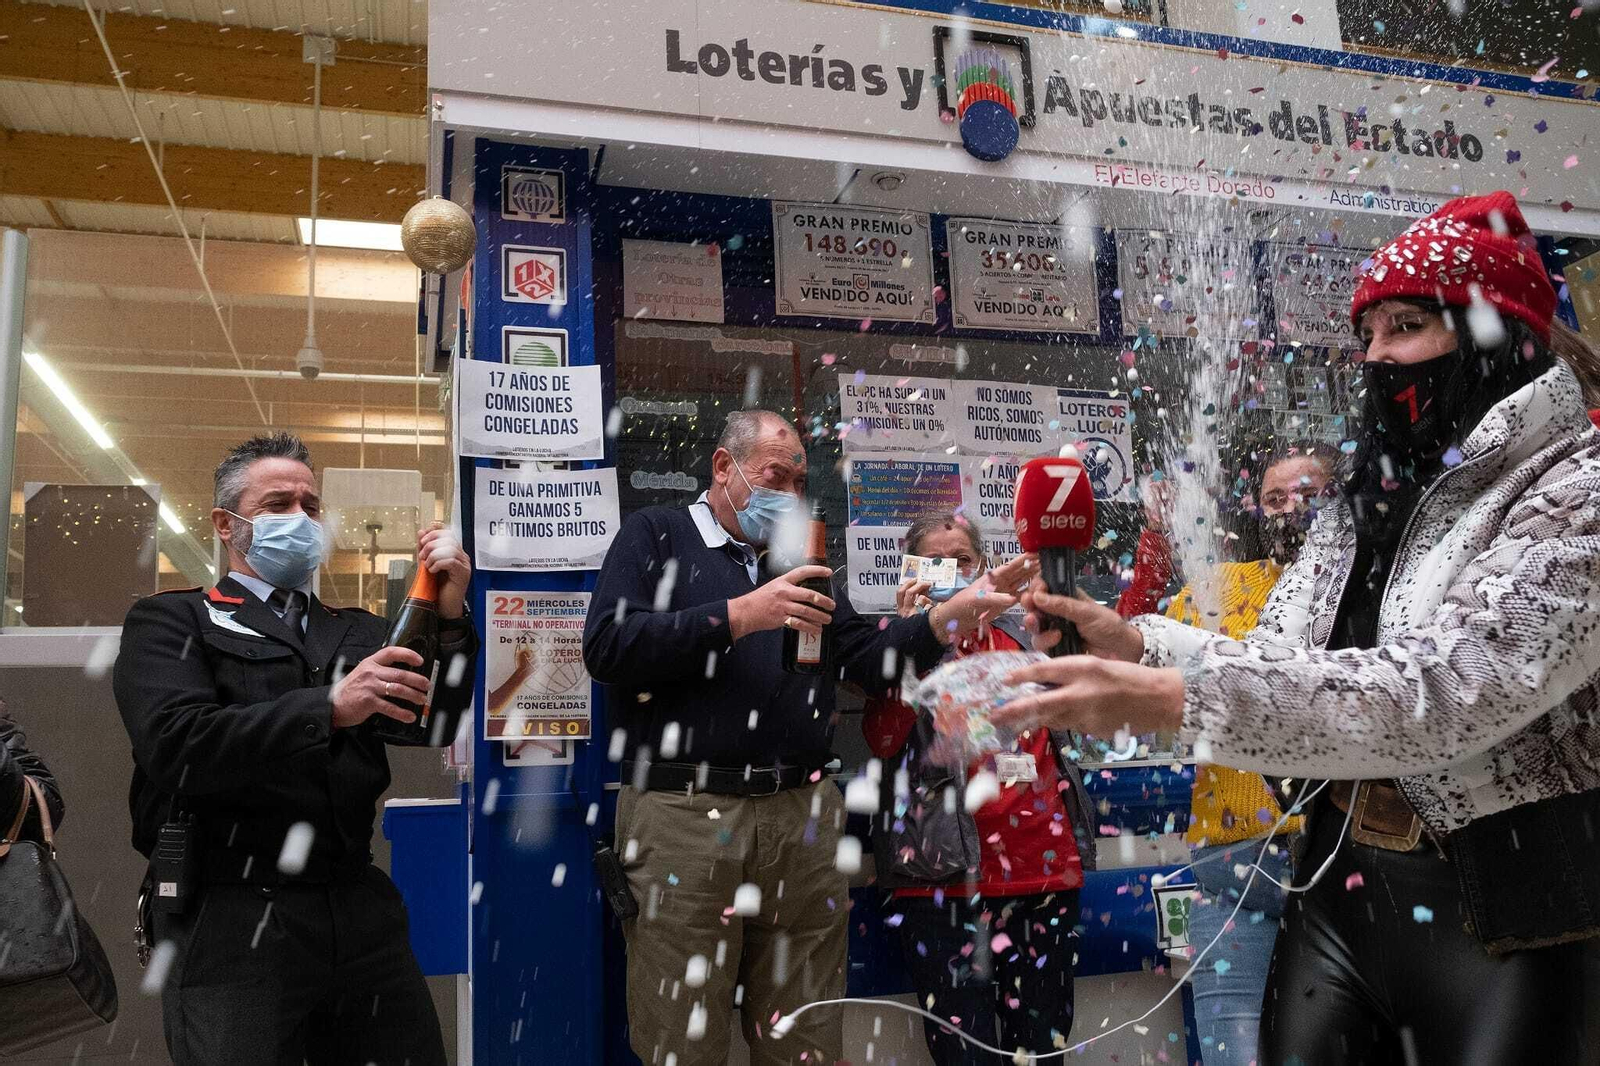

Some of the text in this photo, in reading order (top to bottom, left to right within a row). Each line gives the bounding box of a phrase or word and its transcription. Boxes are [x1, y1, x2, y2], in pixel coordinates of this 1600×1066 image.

[665, 29, 925, 111] Loterías y
[1043, 75, 1256, 137] Apuestas
[1268, 100, 1332, 146] del
[1121, 167, 1201, 192] Elefante
[1207, 175, 1275, 200] Dorado
[1330, 189, 1440, 215] Admnistración
[793, 213, 913, 236] GRAN PREMIO
[804, 233, 897, 258] 148.690
[965, 230, 1011, 247] GRAN
[866, 259, 893, 267] ESTRELLA
[831, 277, 852, 287] Euro
[870, 280, 906, 291] Millones
[633, 291, 722, 307] provincias
[800, 286, 913, 306] VENDIDO AQUÍ
[974, 300, 1038, 316] VENDIDO
[1294, 319, 1351, 335] VENDIDO
[489, 371, 571, 392] 17 AÑOS DE
[846, 384, 858, 397] EL
[878, 386, 893, 399] HA
[932, 388, 946, 401] UN
[976, 387, 1033, 405] NO SOMOS
[485, 393, 573, 413] COMISIONES
[885, 402, 935, 416] NUESTRAS
[1059, 401, 1127, 419] LOTEROS
[484, 415, 579, 435] CONGELADAS
[912, 418, 926, 431] UN
[928, 419, 945, 432] 0%
[967, 408, 1044, 425] RICOS, SOMOS
[974, 423, 1042, 444] AUTÓNOMOS
[890, 463, 915, 471] LABORAL
[934, 464, 954, 472] LOTERO
[998, 462, 1019, 480] AÑO
[489, 480, 602, 498] DE UNA PRIMITIVA
[979, 483, 1014, 498] COMIS
[1042, 465, 1083, 512] 7
[509, 501, 582, 517] GANAMOS 5
[980, 502, 1014, 518] CONG
[489, 518, 606, 537] CÉNTIMOS BRUTOS
[1040, 513, 1087, 530] siete
[857, 537, 895, 551] DE UNA
[992, 540, 1006, 553] UN
[874, 554, 903, 569] GANA
[858, 569, 900, 586] CÉNTIM
[494, 597, 584, 616] 22 MIÉRCOLES
[526, 608, 587, 616] SEPTIEMBRE
[533, 620, 543, 629] NO
[500, 636, 512, 644] De
[515, 636, 527, 644] 12
[553, 636, 582, 644] Horas
[539, 649, 582, 657] LOTERO
[517, 701, 587, 710] CONGELADAS
[520, 721, 580, 736] VISO
